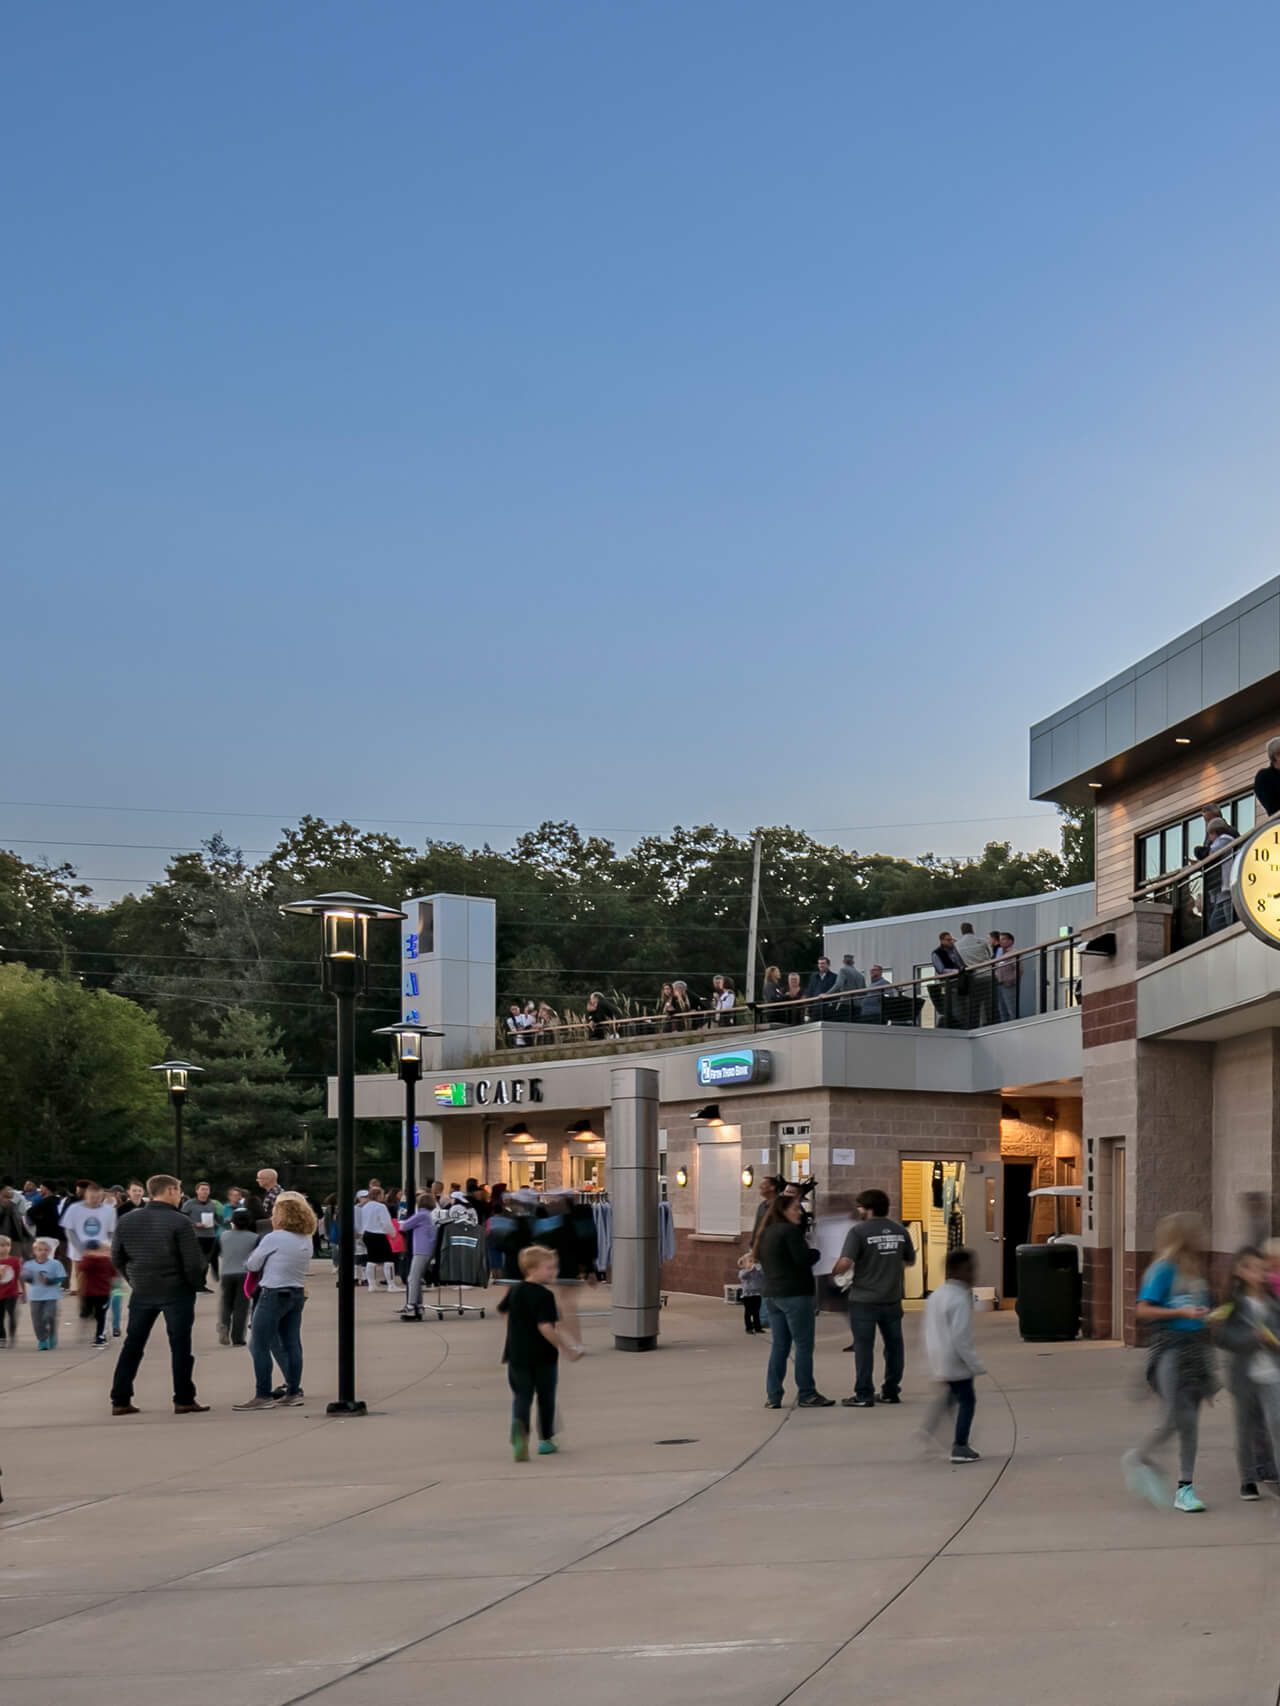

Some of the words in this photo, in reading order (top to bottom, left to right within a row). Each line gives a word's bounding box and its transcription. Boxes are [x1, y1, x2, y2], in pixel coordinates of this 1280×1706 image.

[1254, 848, 1270, 862] 10
[1248, 872, 1257, 886] 9
[1257, 899, 1266, 912] 8
[475, 1077, 544, 1106] CAFE
